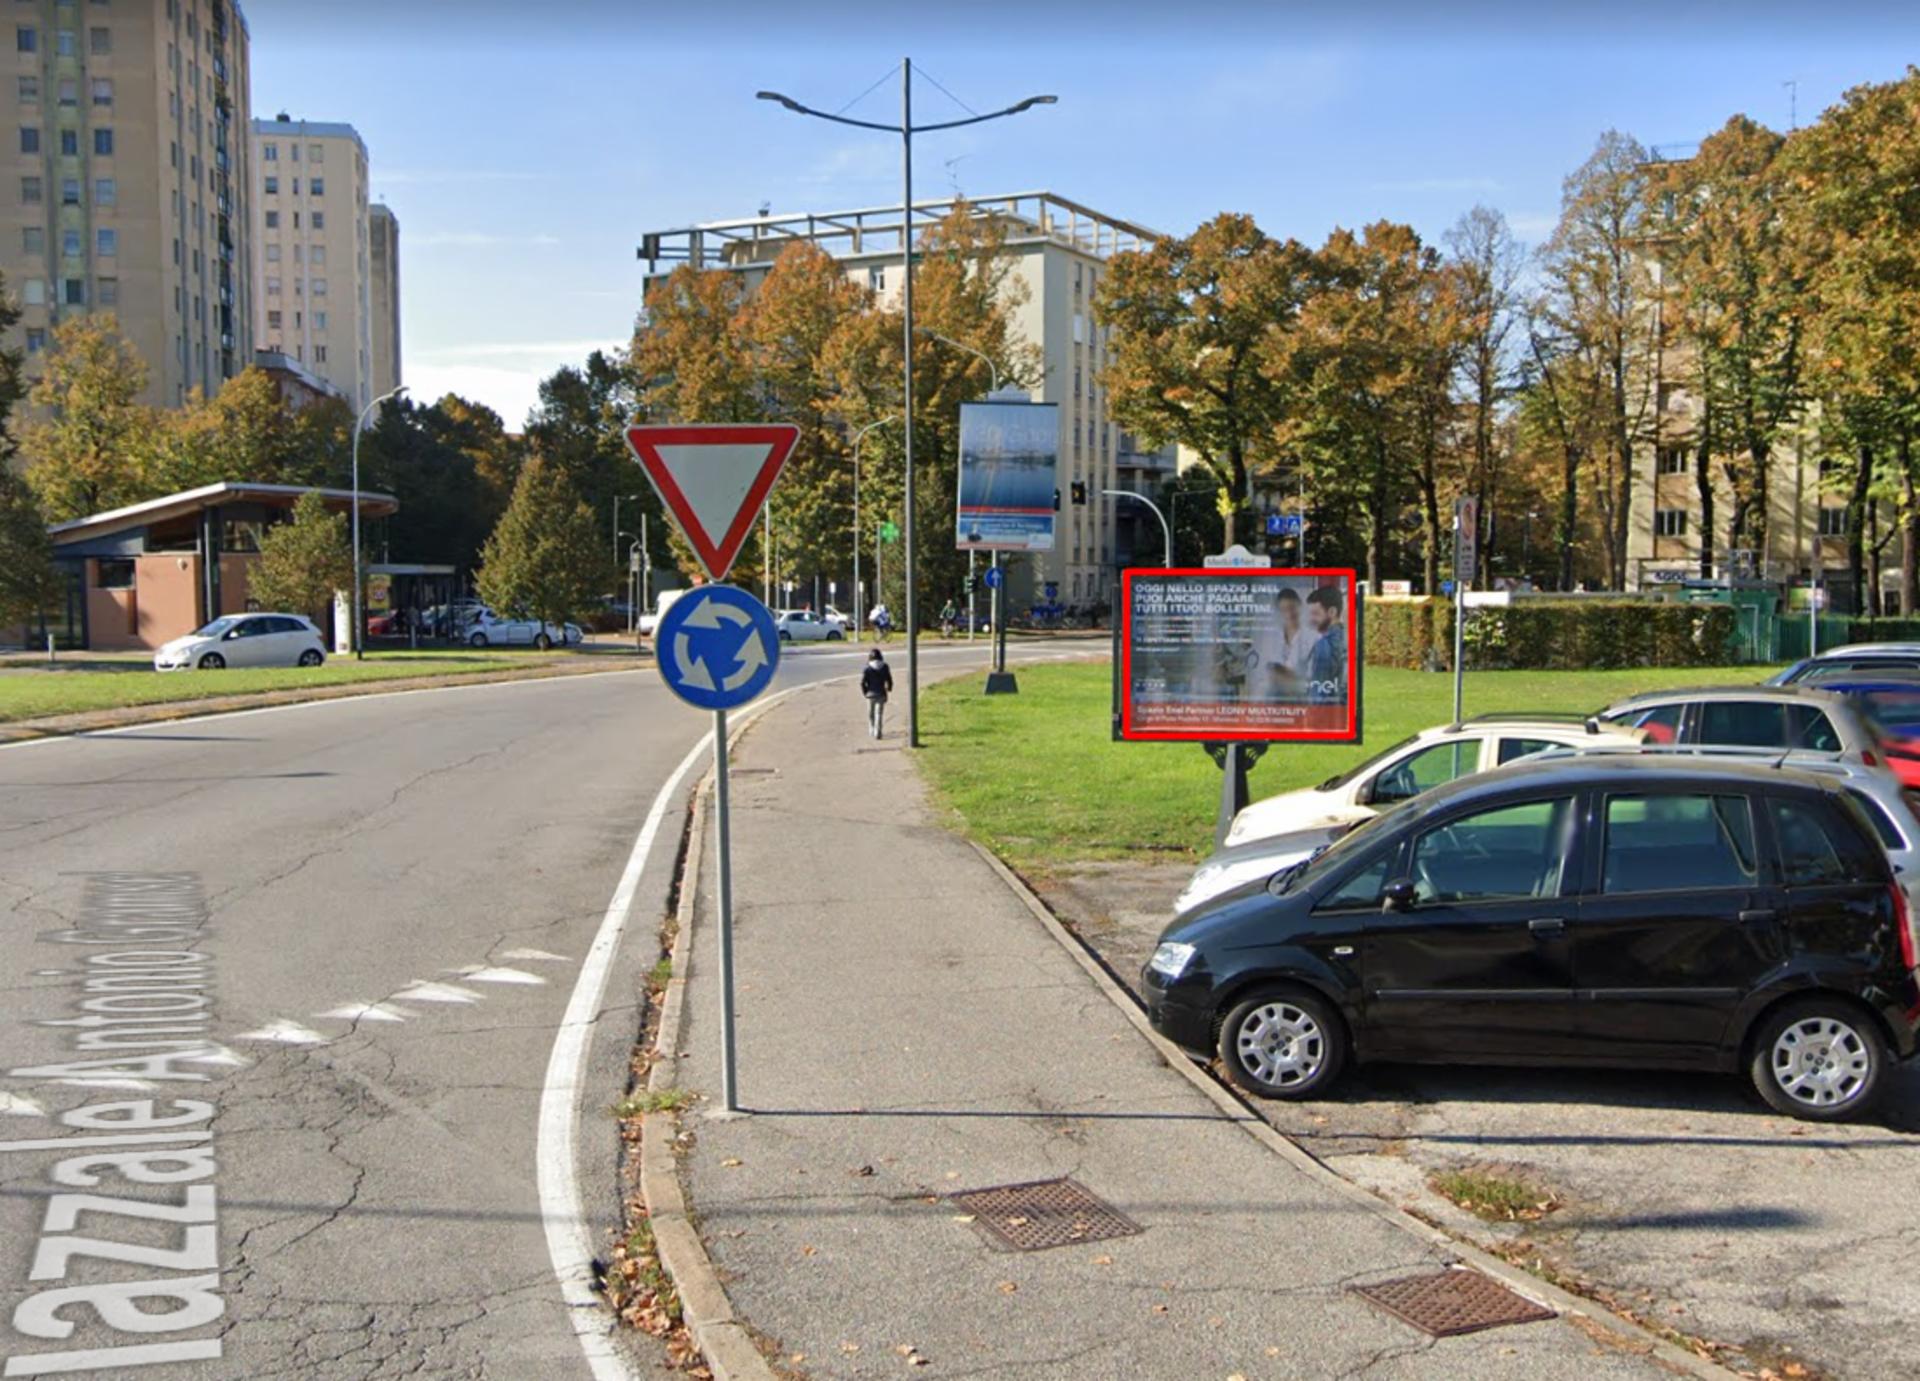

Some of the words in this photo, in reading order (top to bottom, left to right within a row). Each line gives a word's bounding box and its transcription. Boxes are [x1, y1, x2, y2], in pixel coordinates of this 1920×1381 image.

[1134, 583, 1164, 593] OGGI
[1167, 583, 1203, 593] NELLO
[1206, 583, 1248, 593] SPAZIO
[1251, 583, 1280, 593] ENEL
[1135, 593, 1163, 602] PUOI
[1165, 593, 1203, 602] ANCHE
[1207, 593, 1254, 602] PAGARE
[1135, 603, 1167, 613] TUTTI
